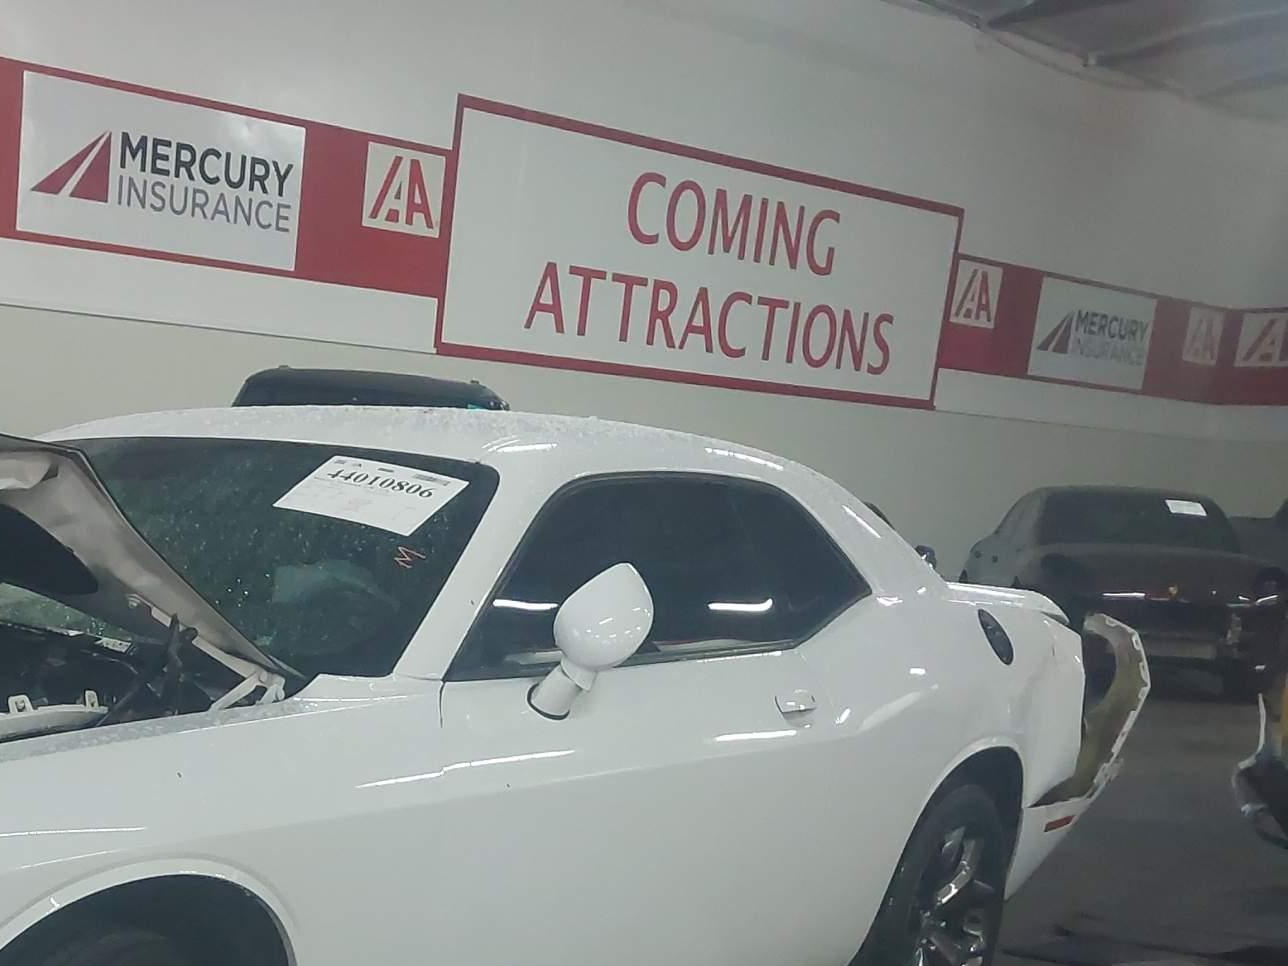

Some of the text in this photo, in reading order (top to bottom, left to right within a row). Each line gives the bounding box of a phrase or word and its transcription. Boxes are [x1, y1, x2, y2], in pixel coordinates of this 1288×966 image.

[119, 132, 294, 197] MERCURY
[117, 175, 292, 233] INSURANCE
[627, 172, 841, 276] COMING
[524, 261, 895, 376] ATTRACTIONS
[1076, 309, 1149, 342] MERCURY
[327, 469, 433, 498] 44010806
